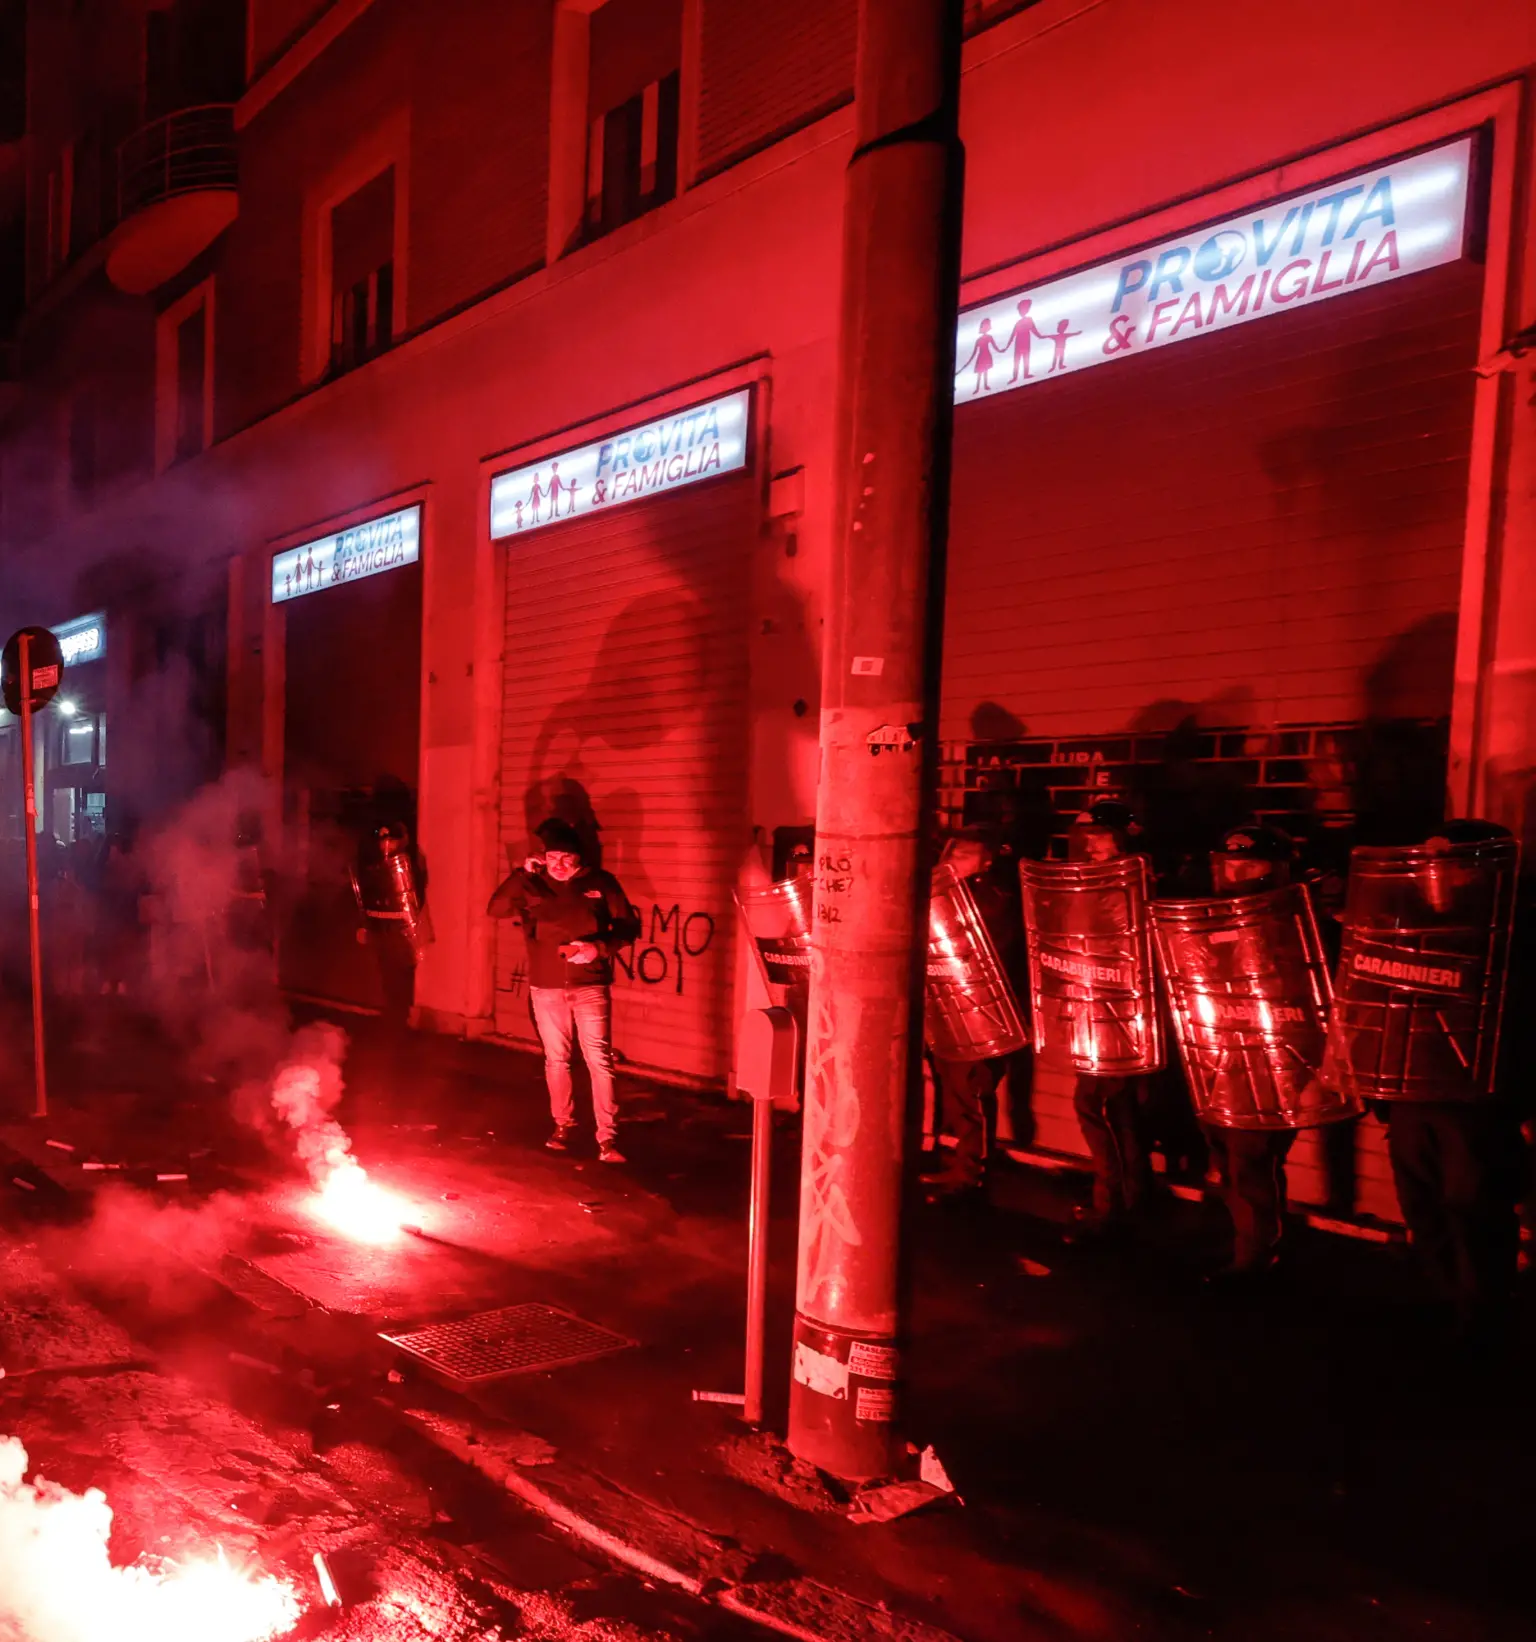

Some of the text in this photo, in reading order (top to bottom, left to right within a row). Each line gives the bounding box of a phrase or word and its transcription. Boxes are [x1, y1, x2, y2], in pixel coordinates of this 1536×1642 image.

[1110, 175, 1395, 313] PROVITA
[1102, 229, 1400, 355] & FAMIGLIA
[595, 405, 719, 477] PROVITA
[591, 442, 721, 505] & FAMIGLIA
[331, 542, 404, 582] & FAMIGLIA
[333, 516, 403, 561] PROVITA
[1354, 954, 1460, 988] CARABINIERI
